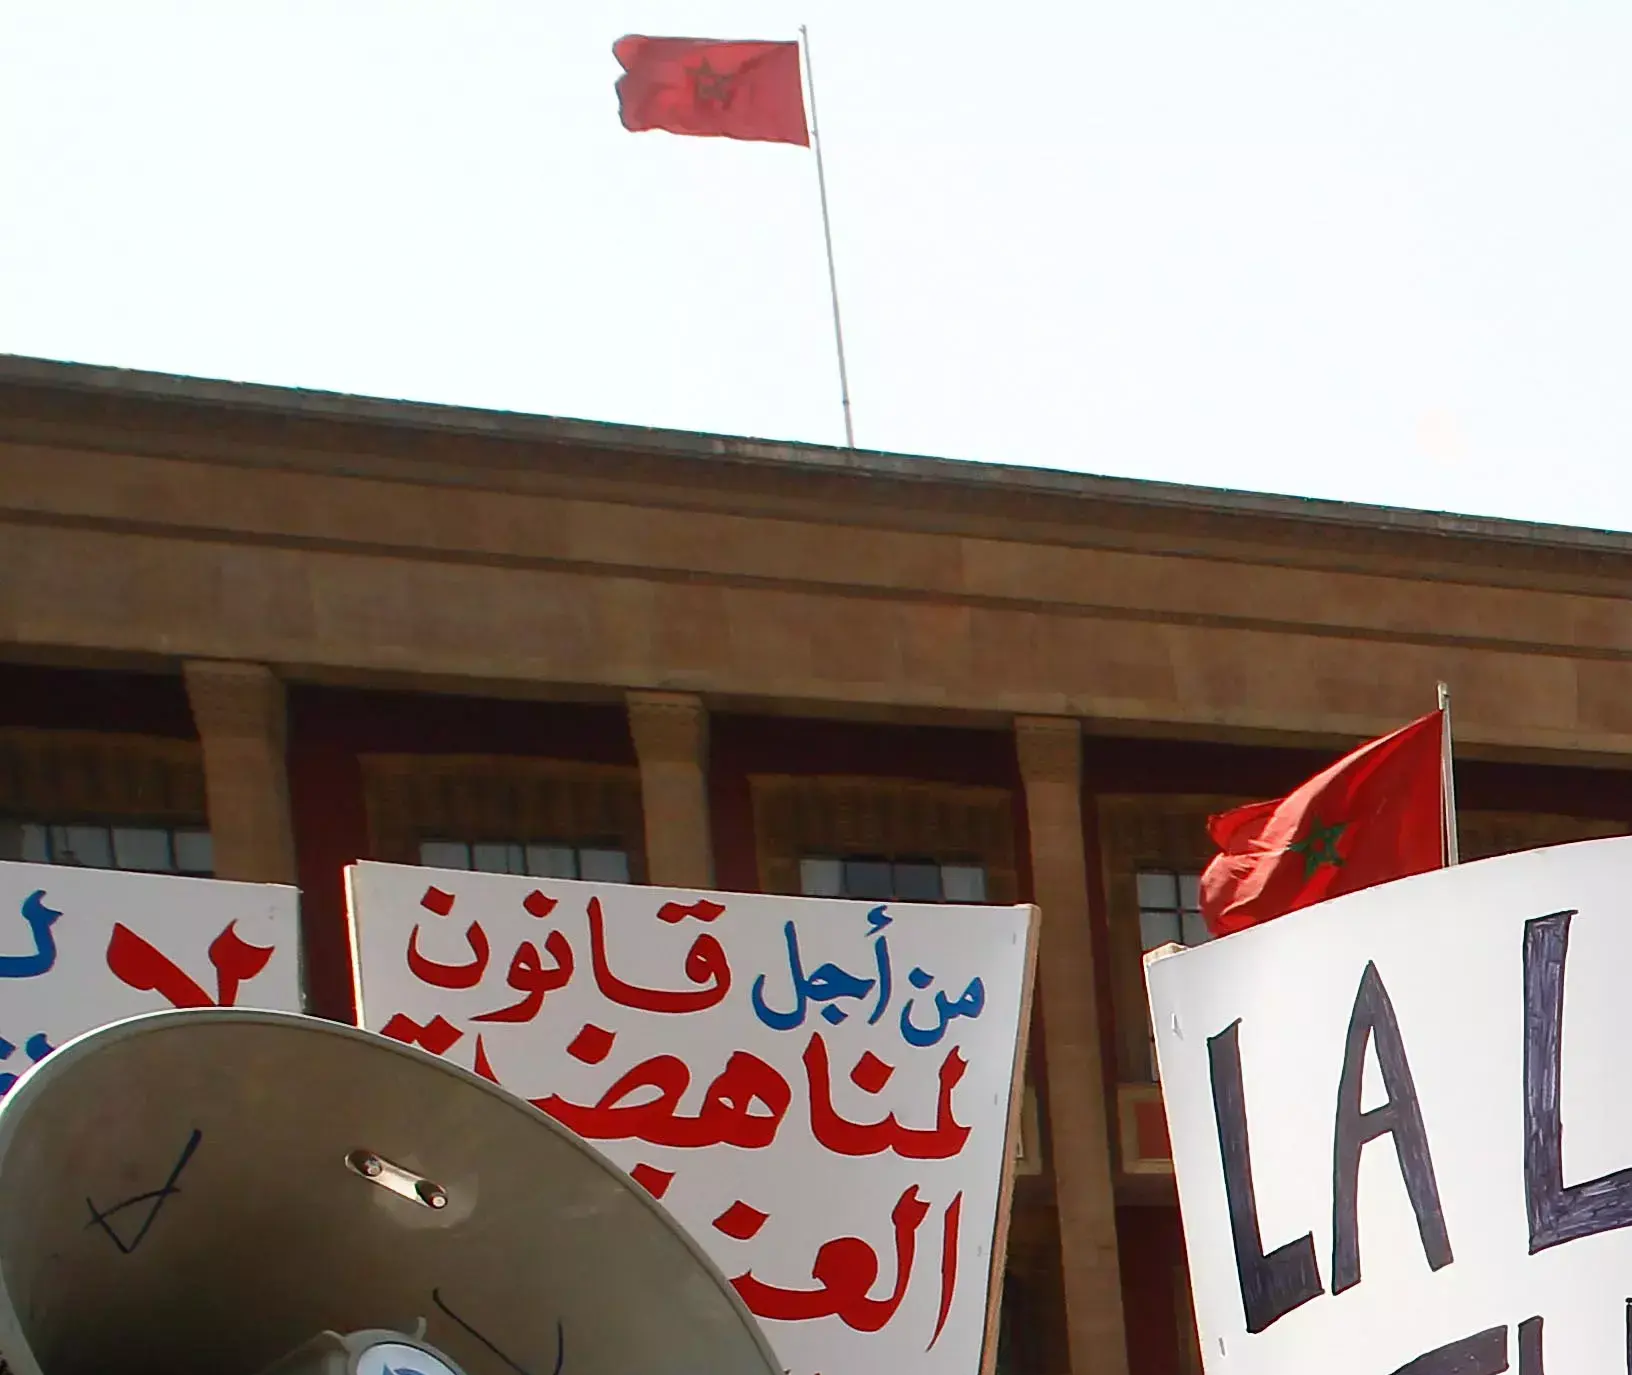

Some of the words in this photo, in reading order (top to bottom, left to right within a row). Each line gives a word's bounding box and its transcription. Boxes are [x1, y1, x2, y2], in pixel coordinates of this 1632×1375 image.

[406, 885, 732, 1023] قانون
[752, 904, 893, 1032] أجل
[899, 966, 985, 1048] من
[1207, 959, 1453, 1333] LA
